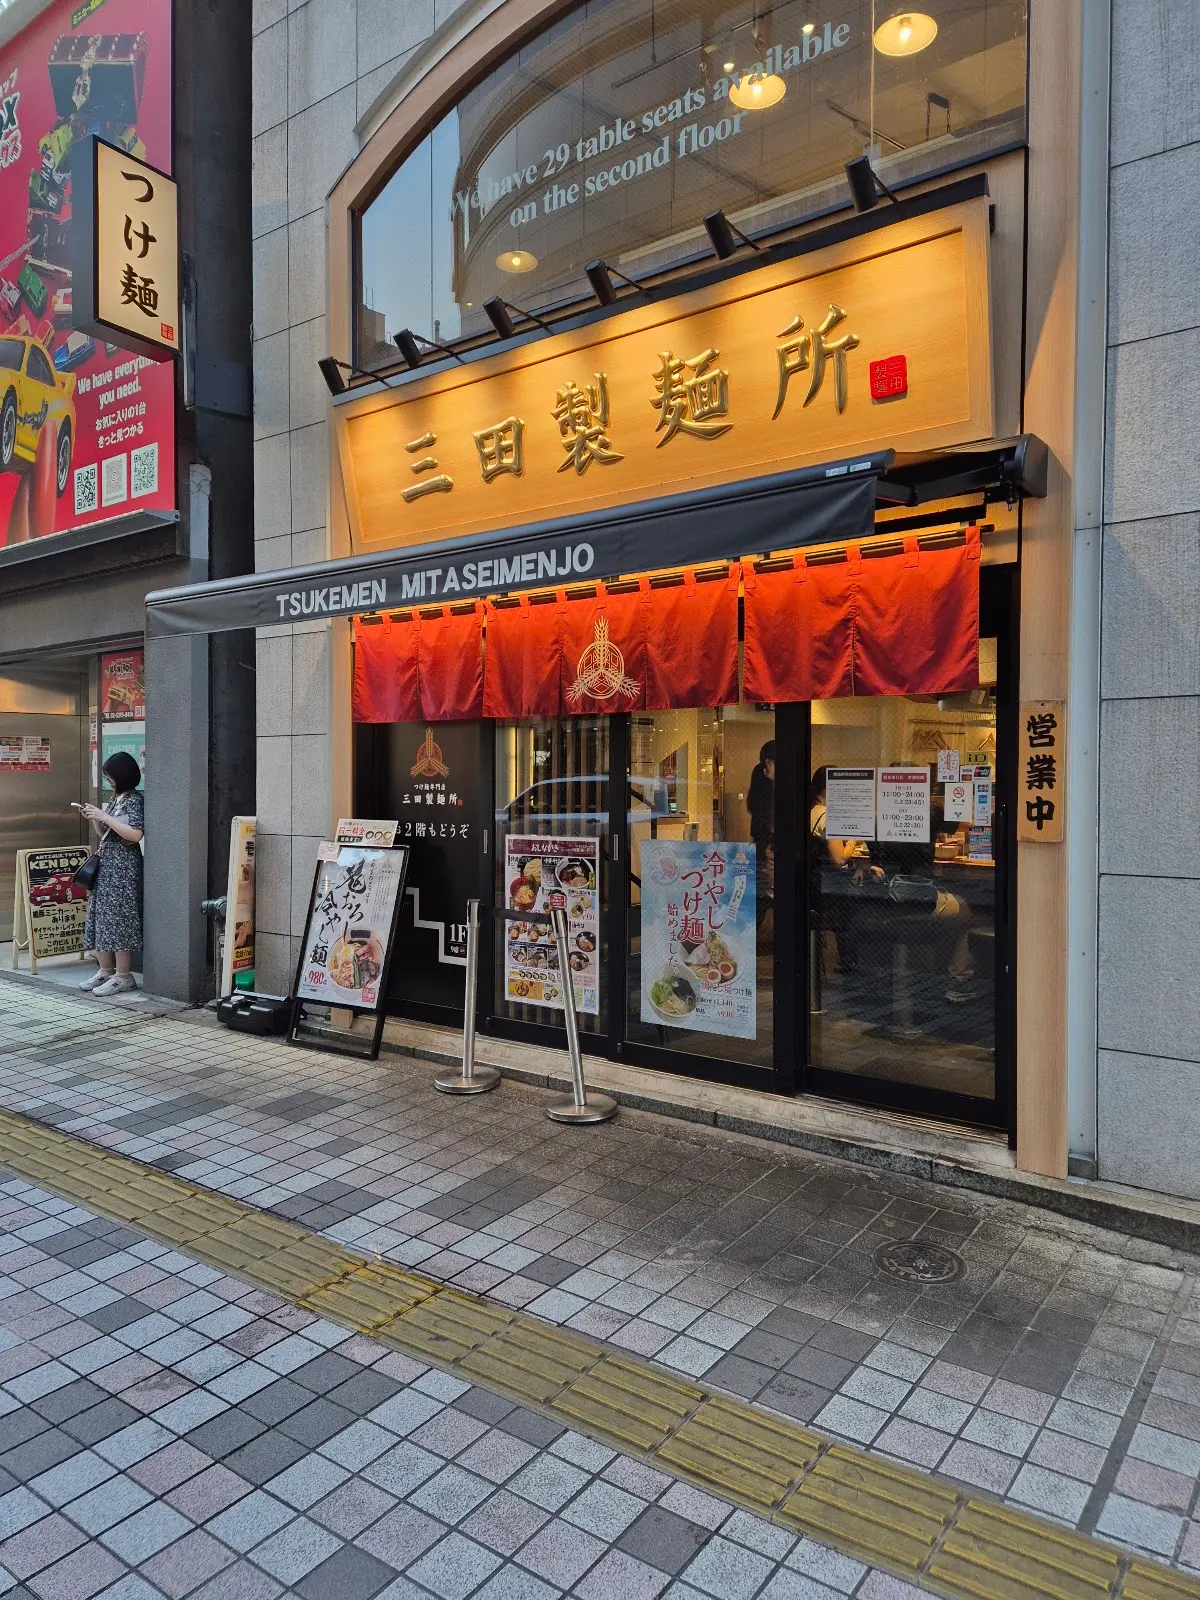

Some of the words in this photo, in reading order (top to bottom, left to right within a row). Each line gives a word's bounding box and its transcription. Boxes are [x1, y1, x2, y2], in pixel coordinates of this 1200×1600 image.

[485, 164, 538, 203] have
[542, 144, 570, 179] 29
[576, 117, 636, 165] table
[642, 85, 706, 133] seats
[713, 21, 851, 103] available
[509, 201, 538, 227] on
[543, 184, 580, 219] the
[585, 140, 671, 195] second
[677, 111, 748, 163] floor
[120, 171, 160, 318] つけ麺
[78, 377, 91, 395] We
[92, 369, 113, 389] have
[99, 389, 114, 410] you
[117, 376, 142, 400] need.
[401, 304, 861, 502] 三田製麺所
[98, 421, 144, 448] きっと見つかる
[276, 578, 387, 619] TSUKEMEN
[401, 542, 595, 600] MITASEIMENJO
[968, 753, 987, 763] iD
[1026, 713, 1057, 831] 営業中
[402, 792, 458, 806] 三田製麺所
[29, 859, 58, 870] KEN
[702, 851, 727, 930] 冷やし
[450, 923, 468, 943] 1F
[678, 871, 706, 945] つけ麺
